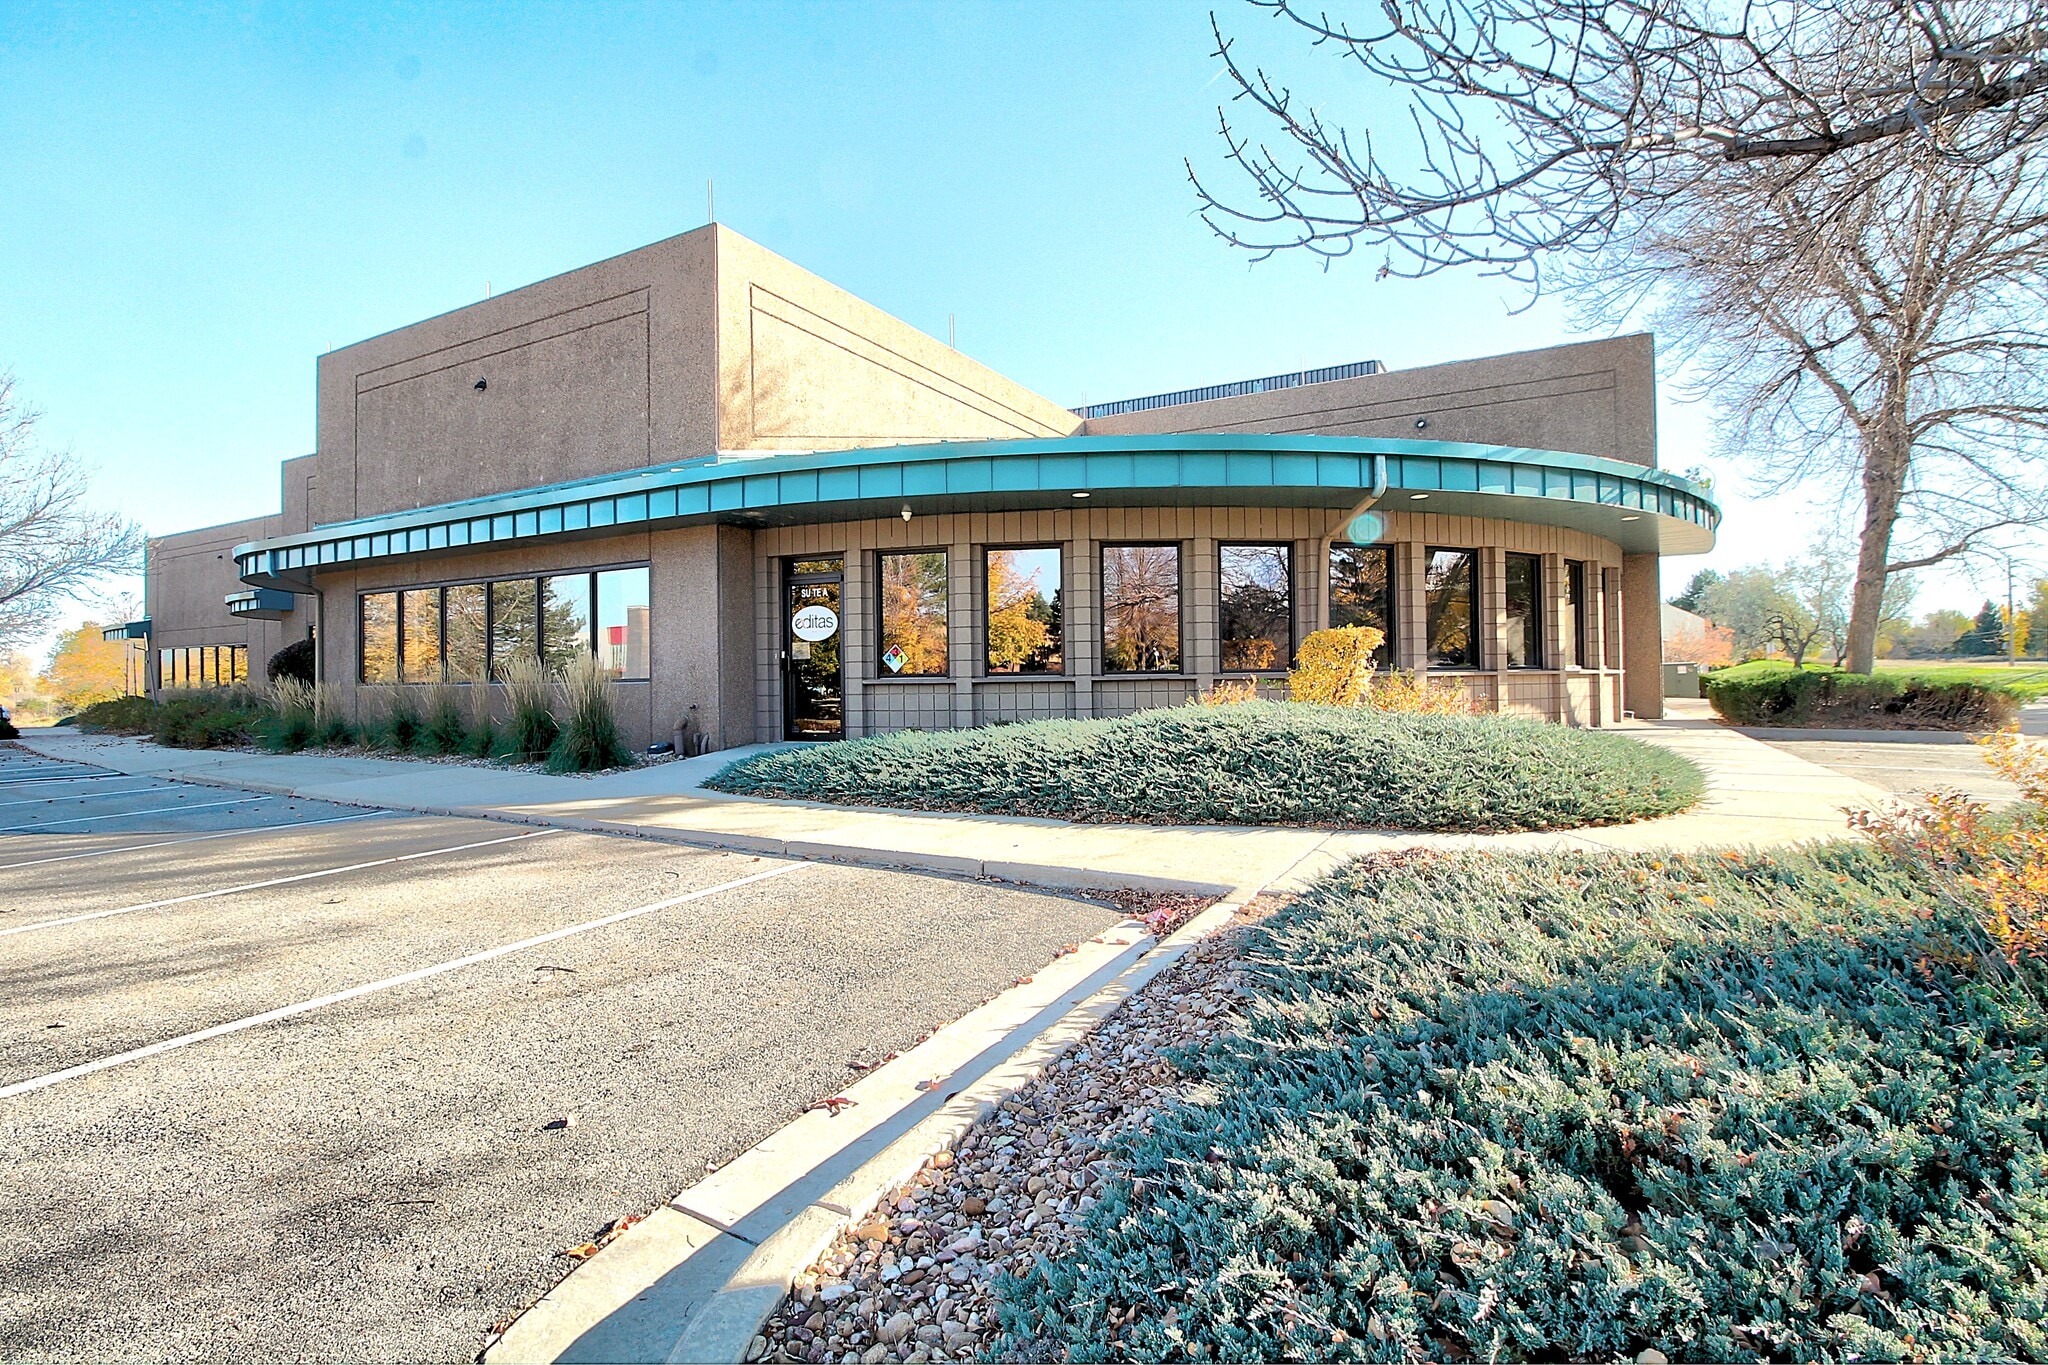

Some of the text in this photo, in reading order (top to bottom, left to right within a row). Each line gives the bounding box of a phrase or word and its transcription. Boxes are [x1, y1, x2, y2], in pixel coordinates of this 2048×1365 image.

[801, 588, 828, 598] SUTE A
[795, 614, 834, 630] editas
[885, 654, 892, 662] 4
